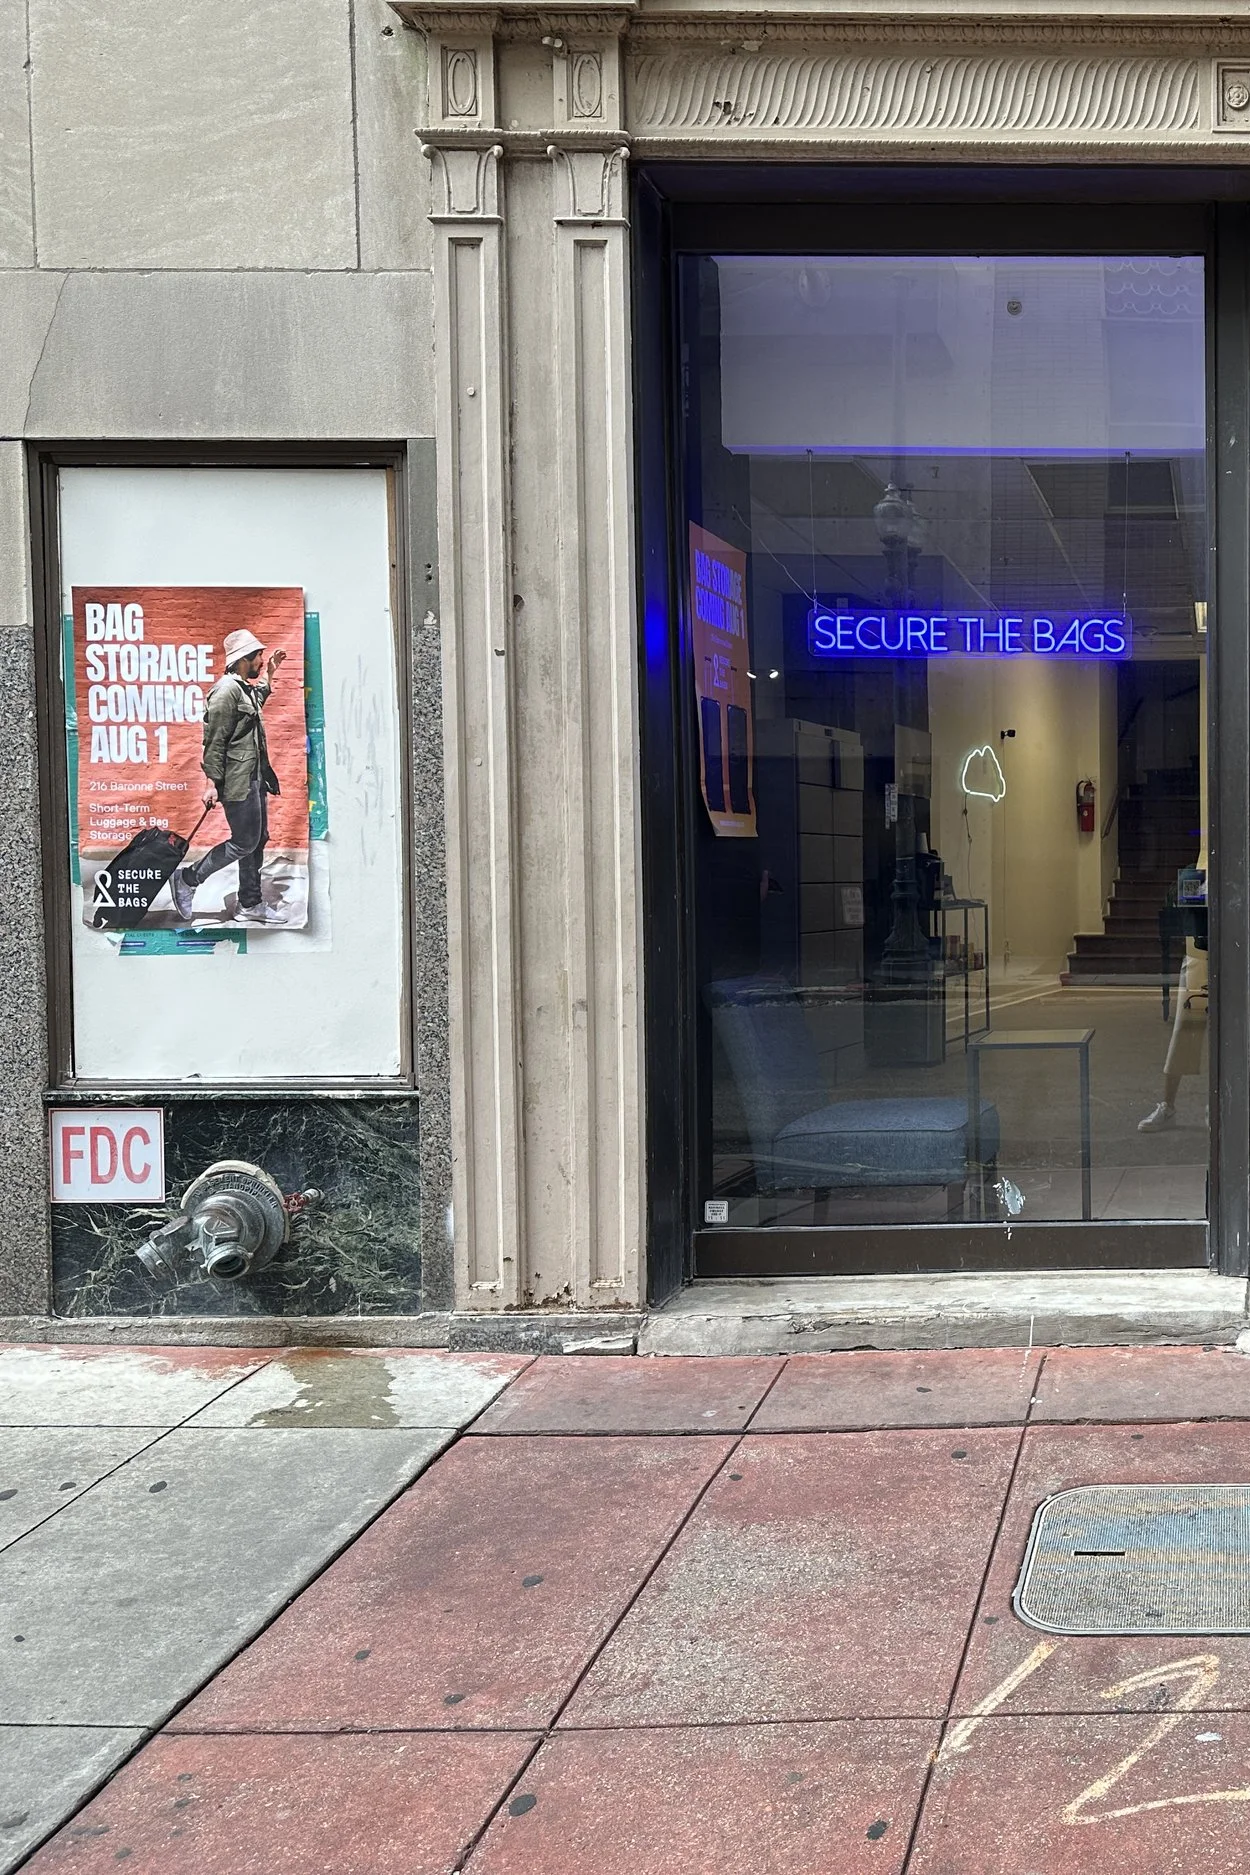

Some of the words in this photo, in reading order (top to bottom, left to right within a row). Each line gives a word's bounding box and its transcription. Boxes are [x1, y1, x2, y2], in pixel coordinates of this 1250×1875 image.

[694, 548, 712, 589] BAG
[85, 603, 144, 641] BAG
[814, 616, 948, 652] SECURE
[959, 617, 1023, 652] THE
[1032, 618, 1126, 654] BAGS
[85, 643, 215, 682] STORAGE
[88, 684, 205, 723] COMING
[90, 725, 148, 764] AUG
[154, 725, 168, 764] 1
[89, 782, 107, 791] 216
[110, 782, 153, 791] Baronne
[155, 781, 188, 791] Street
[89, 803, 150, 813] Short-Term
[90, 817, 138, 828] Luggage
[139, 817, 147, 826] &
[149, 817, 169, 828] Bag
[89, 830, 133, 841] Storage
[118, 869, 161, 880] SECURE
[118, 883, 140, 894] THE
[118, 897, 148, 908] BAGS
[62, 1126, 151, 1185] FDC
